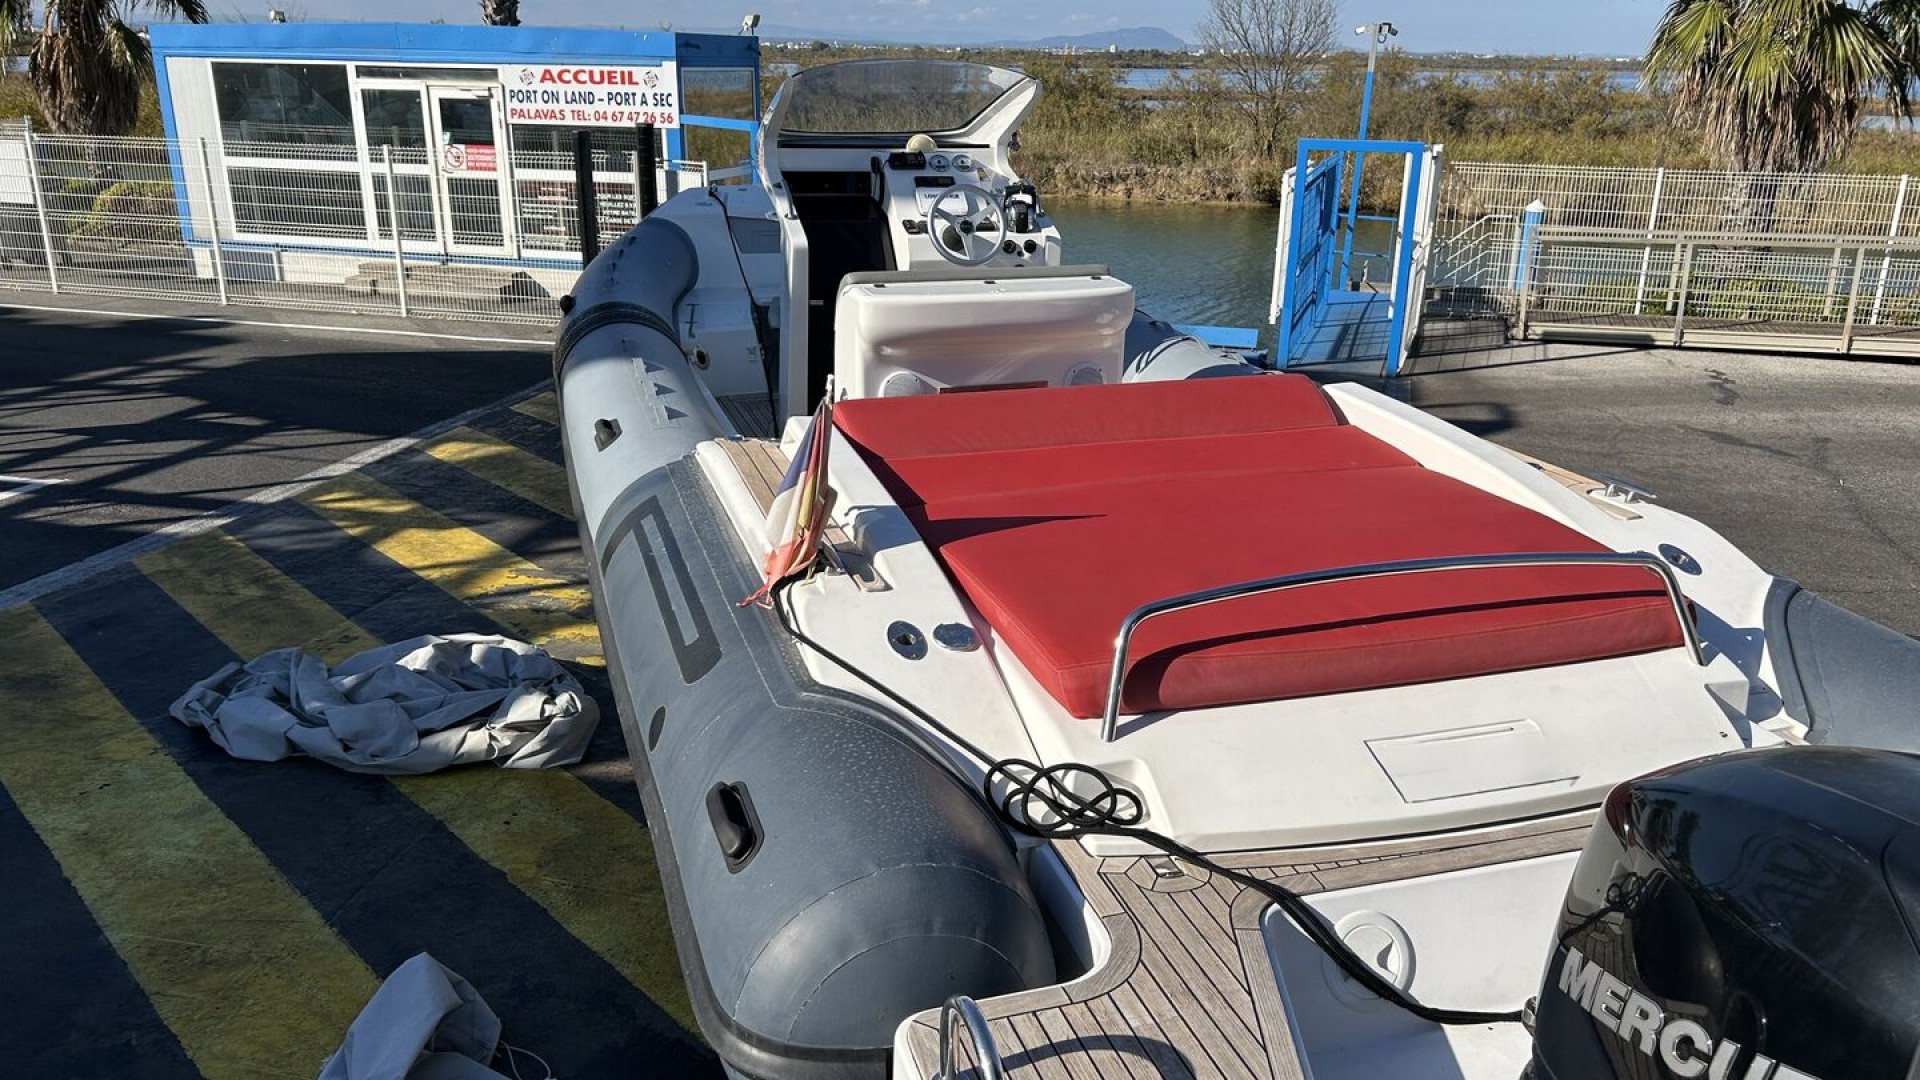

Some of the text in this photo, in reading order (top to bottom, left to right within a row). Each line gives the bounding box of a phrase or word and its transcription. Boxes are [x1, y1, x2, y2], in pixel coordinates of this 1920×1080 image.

[539, 68, 640, 86] ACCUEIL
[508, 88, 538, 105] PORT
[541, 89, 560, 105] ON
[563, 90, 596, 105] LAND
[607, 91, 637, 107] PORT
[640, 92, 649, 108] A
[652, 92, 673, 108] SEC
[510, 107, 674, 125] PALAVAS TEL: 04 67 47 26 56
[1559, 946, 1824, 1080] MERCU
